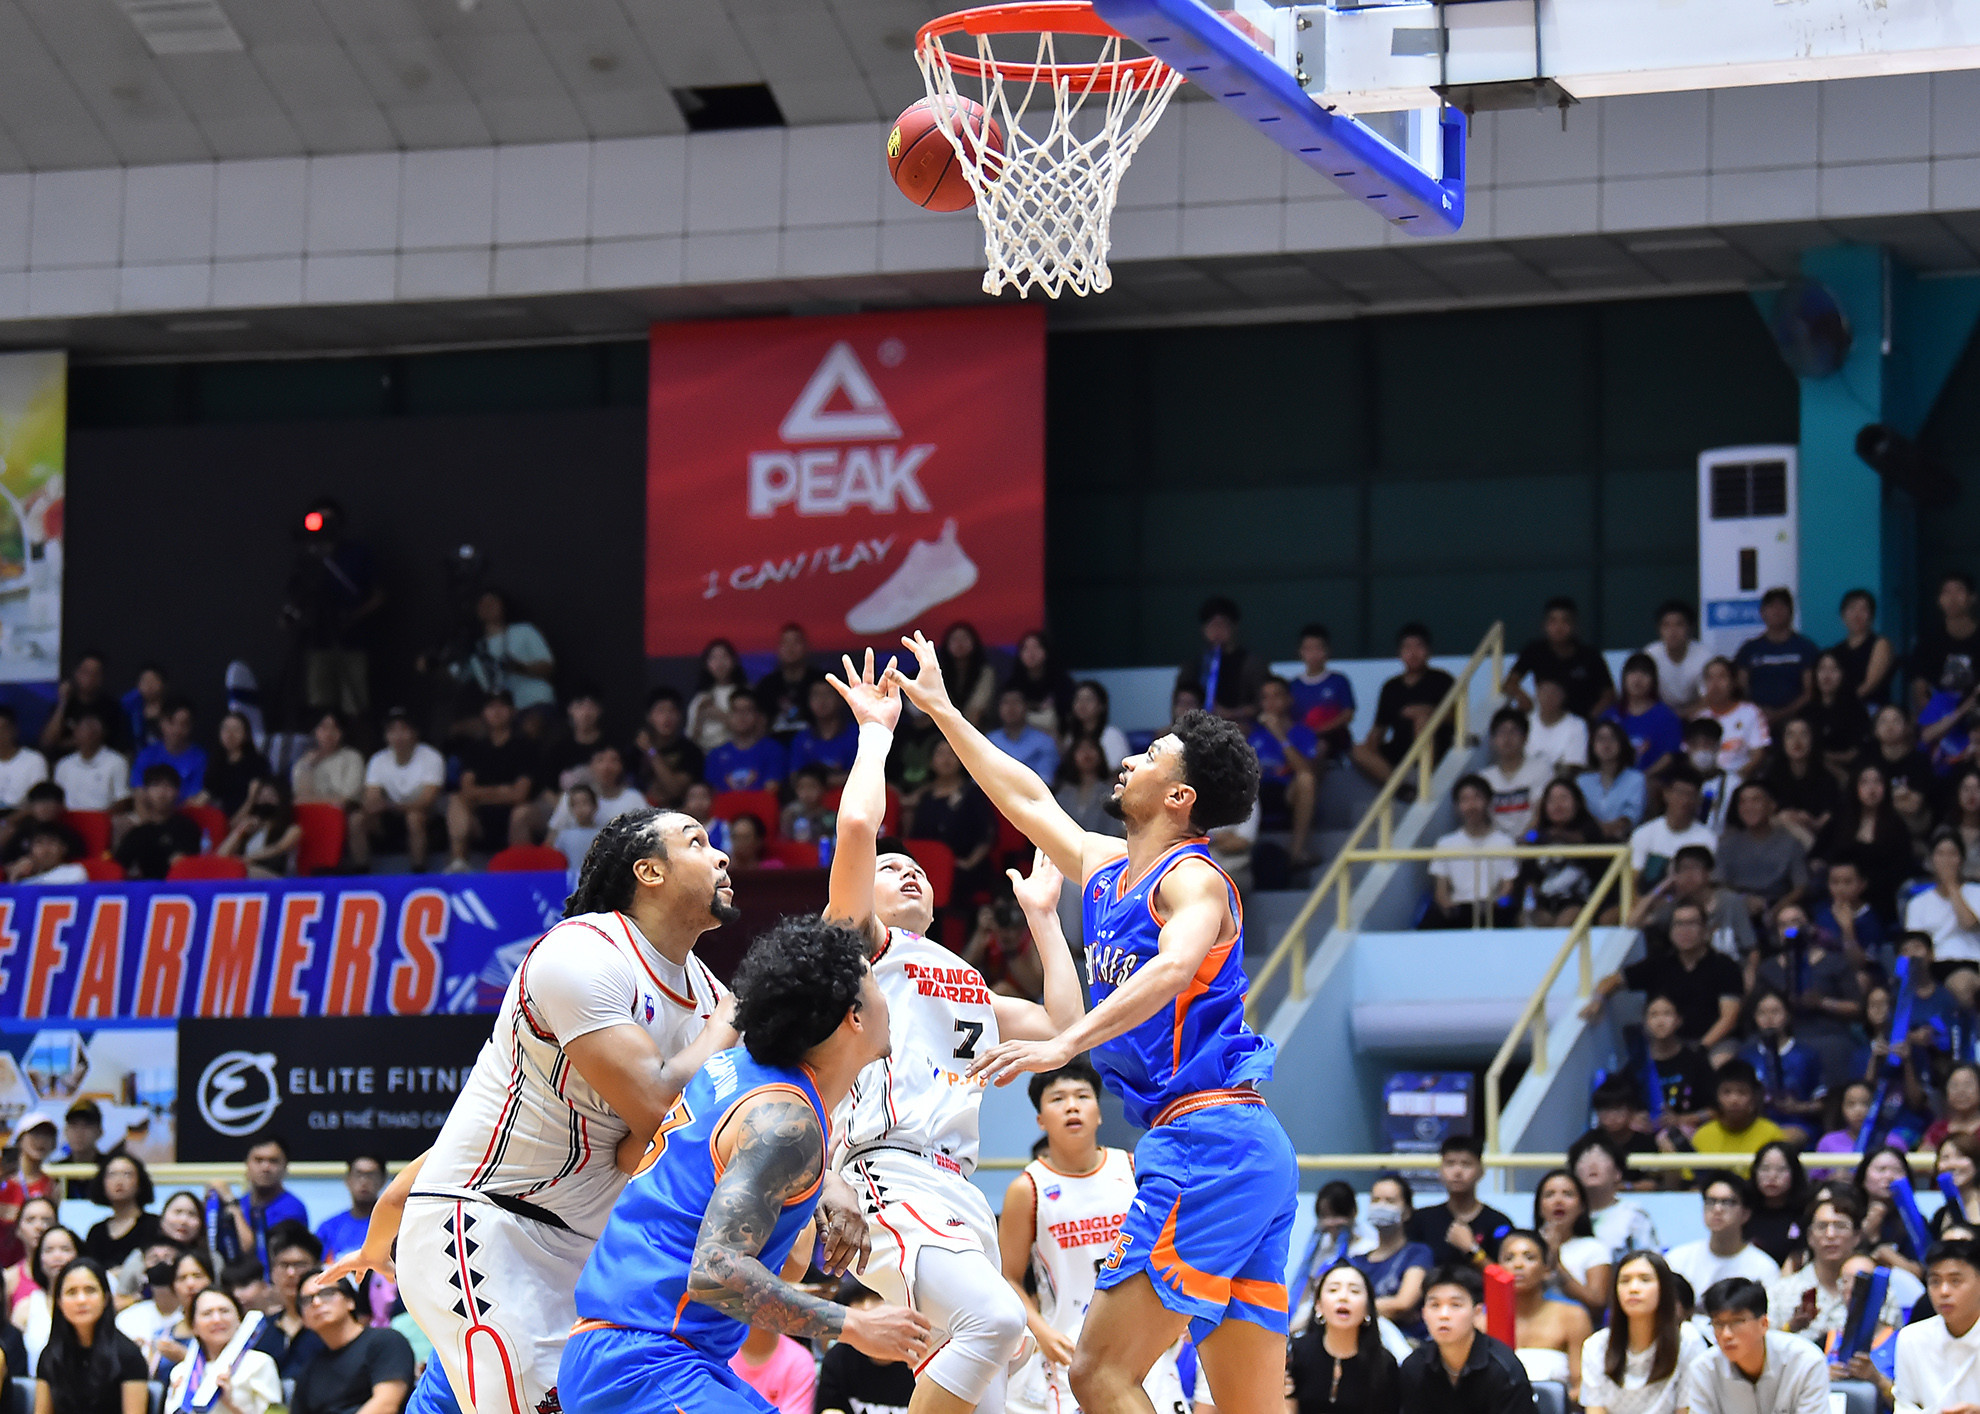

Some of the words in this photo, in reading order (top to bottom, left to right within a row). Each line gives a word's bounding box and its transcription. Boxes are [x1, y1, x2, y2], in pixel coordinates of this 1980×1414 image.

[747, 443, 938, 518] PEAK
[952, 1018, 983, 1060] 7
[288, 1066, 376, 1094] ELITE
